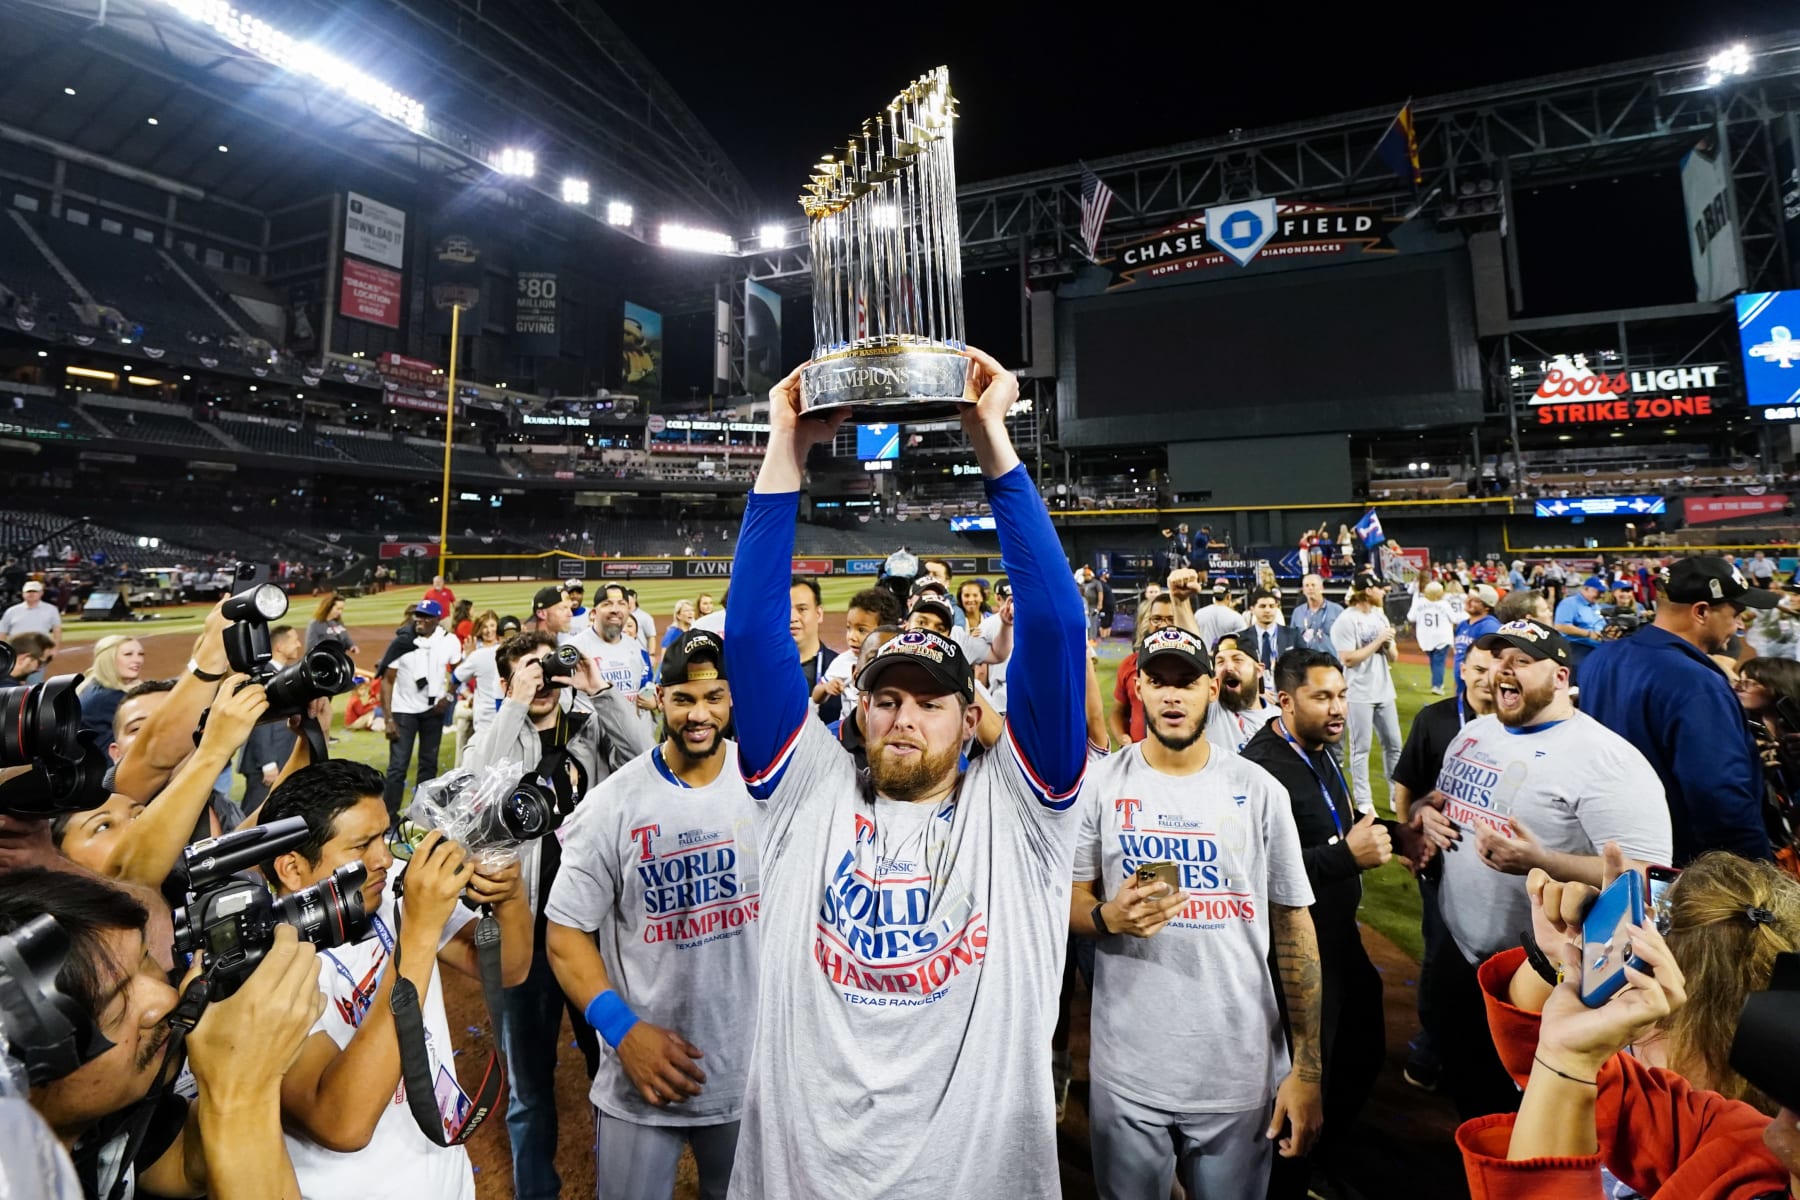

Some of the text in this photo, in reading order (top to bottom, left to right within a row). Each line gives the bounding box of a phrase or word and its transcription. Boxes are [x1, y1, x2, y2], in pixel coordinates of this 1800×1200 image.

[1124, 216, 1373, 265] CHASE FIELD
[1152, 244, 1341, 275] HOME OF THE DIAMONDBACKS
[353, 287, 392, 305] LOCATION
[517, 298, 556, 309] MILLION
[518, 278, 557, 299] $80
[516, 322, 555, 334] GIVING
[1537, 366, 1719, 398] Coors LIGHT
[1537, 395, 1712, 425] STRIKE ZONE
[1424, 613, 1439, 628] 61
[926, 633, 957, 658] SERIES
[1455, 738, 1478, 758] T
[1446, 758, 1498, 788] WORLD
[1115, 798, 1143, 832] T
[631, 824, 660, 863] T
[1118, 834, 1218, 863] WORLD
[638, 848, 736, 888] WORLD
[1122, 858, 1220, 889] SIES
[644, 873, 738, 914] SERIES
[643, 900, 760, 944] CHAMPIONS
[1177, 899, 1255, 920] MPIONS
[675, 929, 743, 950] TEXAS RANGERS
[814, 924, 988, 995] CHAMPIONS
[844, 992, 887, 1006] TEXAS
[458, 1107, 488, 1141] anon
